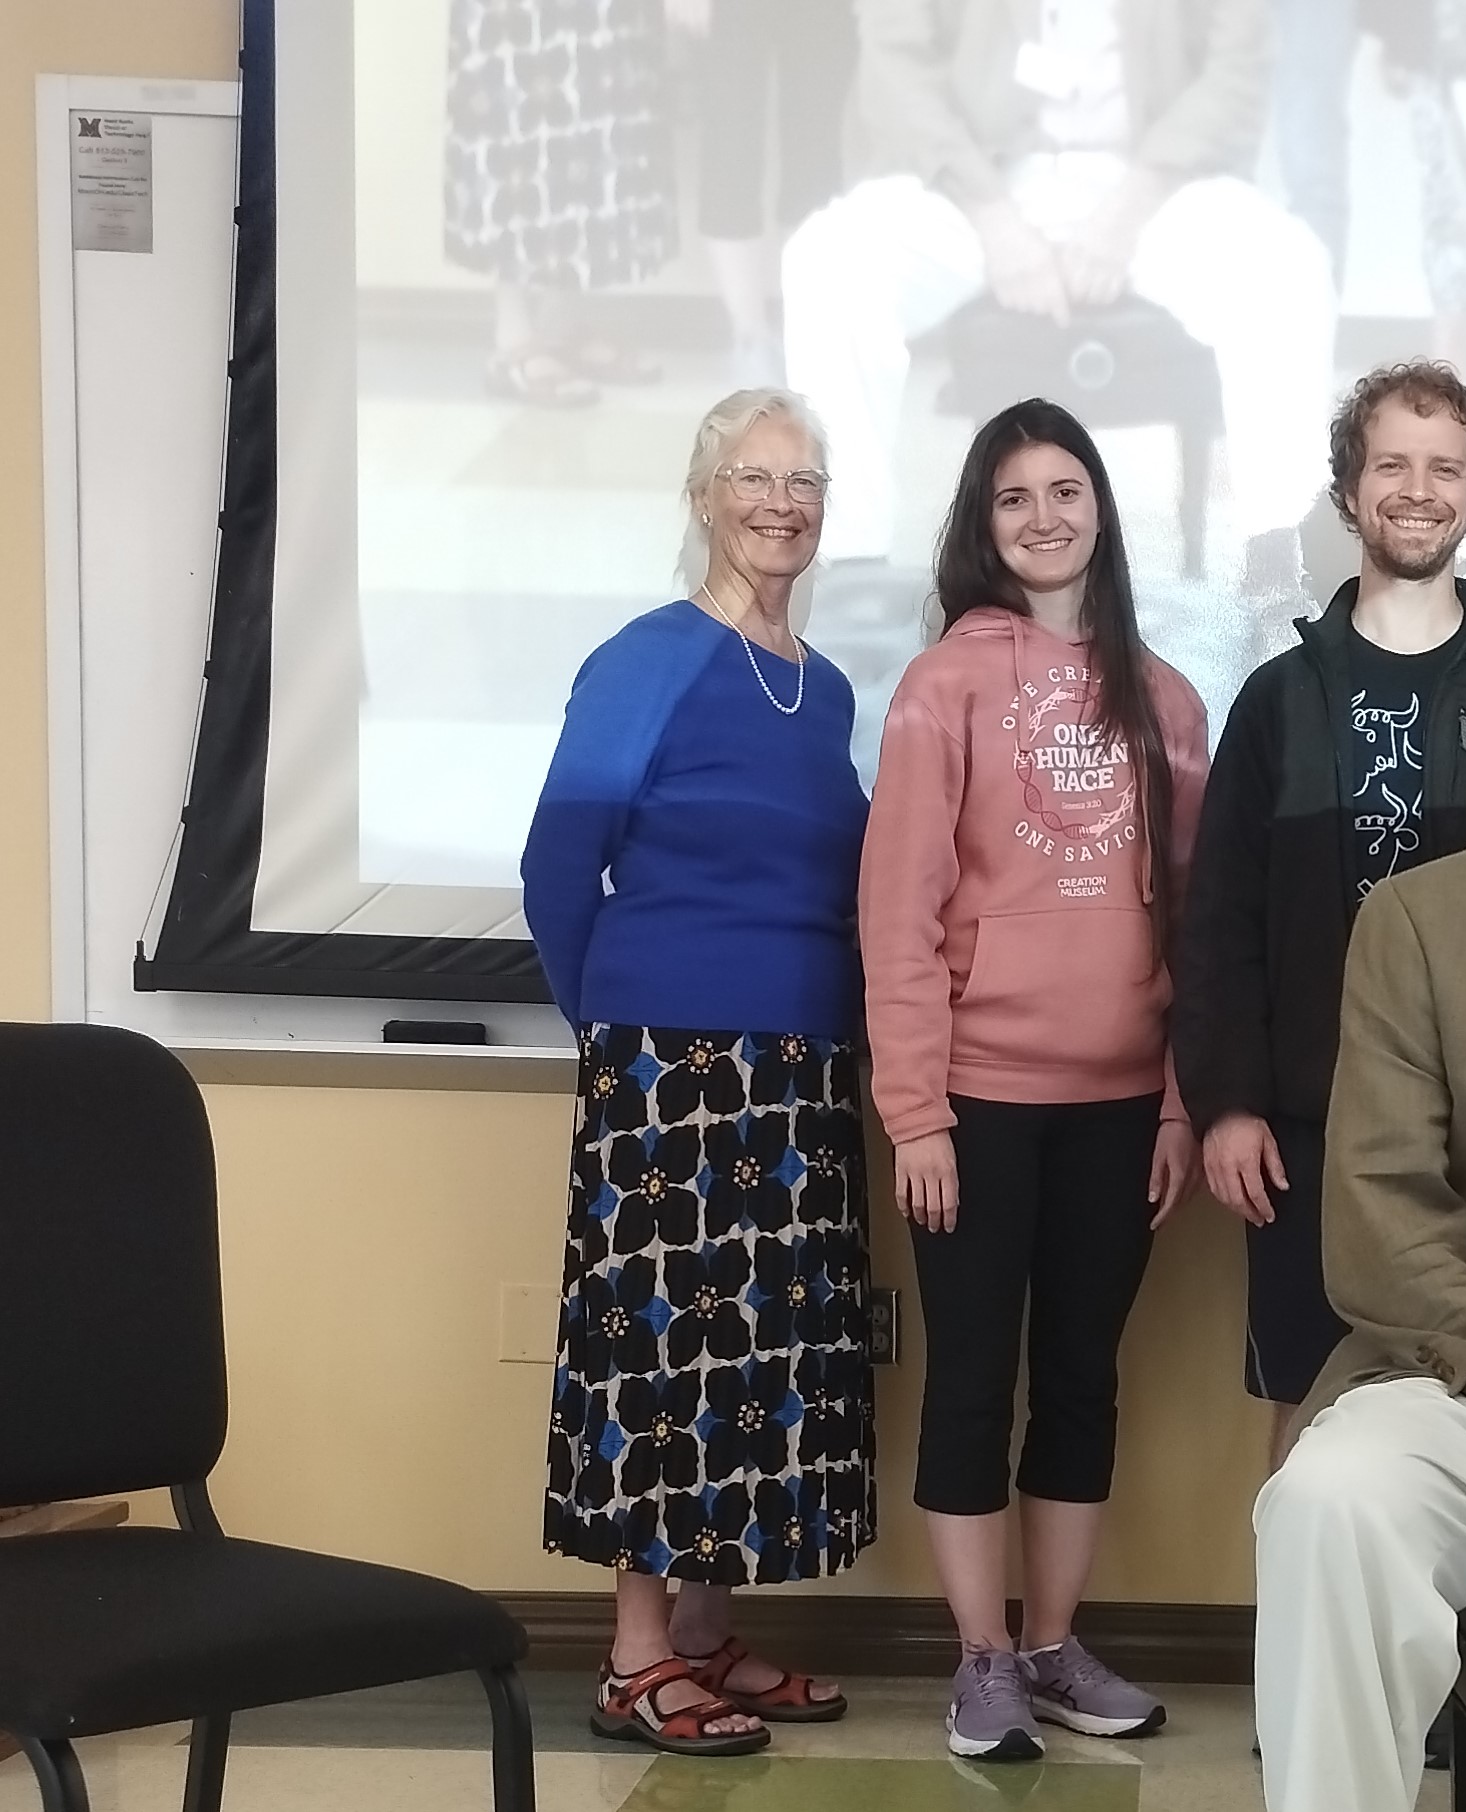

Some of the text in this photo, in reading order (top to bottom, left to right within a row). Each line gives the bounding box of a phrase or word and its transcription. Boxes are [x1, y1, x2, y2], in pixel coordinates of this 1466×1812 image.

[1048, 665, 1102, 683] CRE
[1053, 723, 1105, 745] ONE
[1035, 742, 1129, 770] HUMAN
[1052, 767, 1115, 792] RACE
[1015, 821, 1056, 856] ONE
[1057, 875, 1107, 888] CREATION
[1060, 886, 1107, 898] MUSEUM
